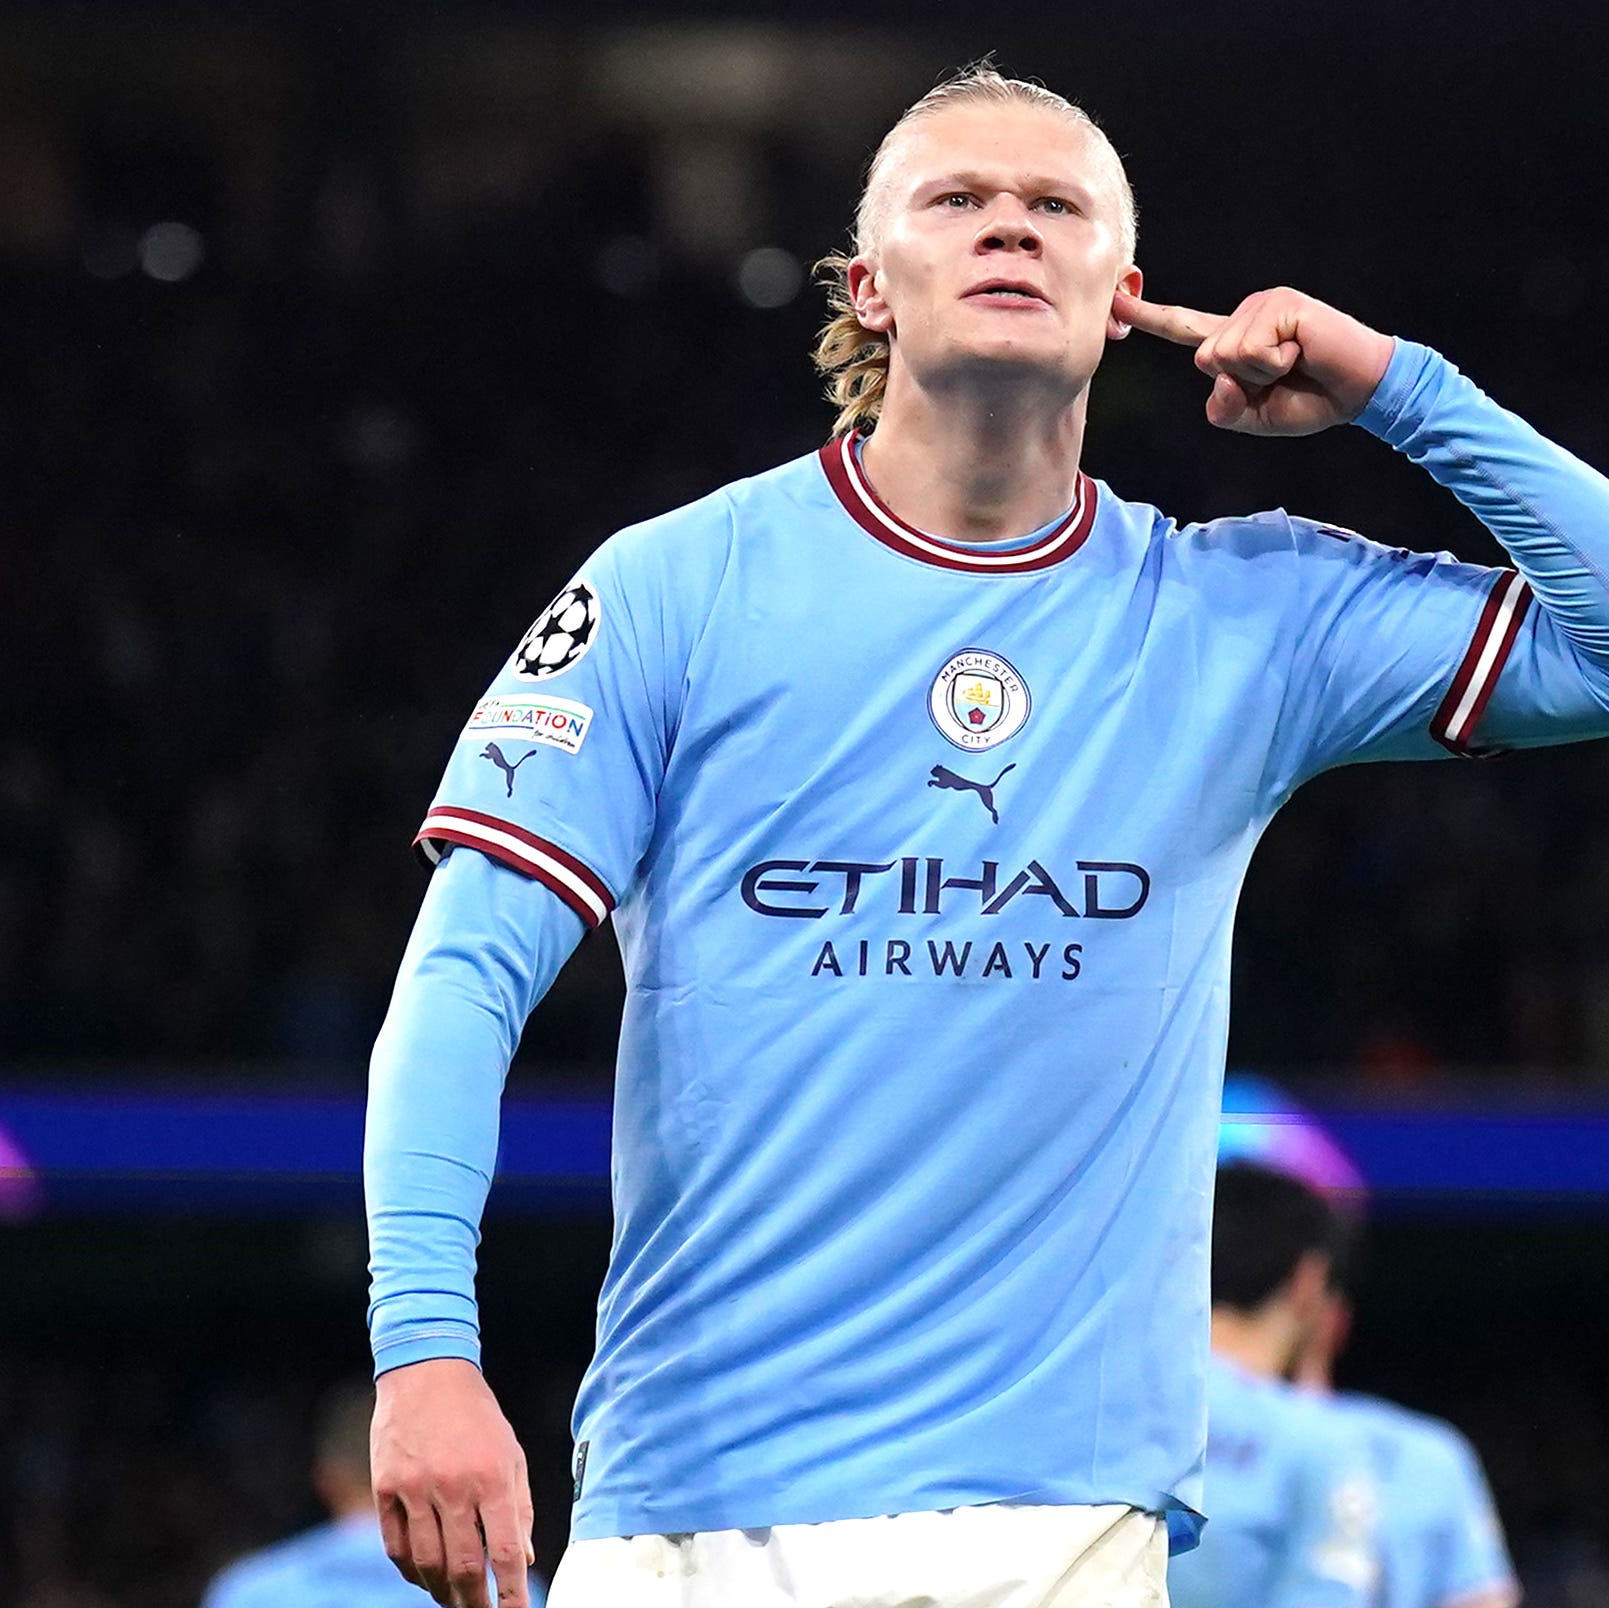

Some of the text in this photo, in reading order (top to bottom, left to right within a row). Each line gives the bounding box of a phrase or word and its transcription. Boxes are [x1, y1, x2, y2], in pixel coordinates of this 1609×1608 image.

[941, 656, 1019, 693] MANCHESTER
[961, 734, 991, 744] CITY
[739, 857, 1151, 919] ETIHAD
[811, 939, 1084, 982] AIRWAYS
